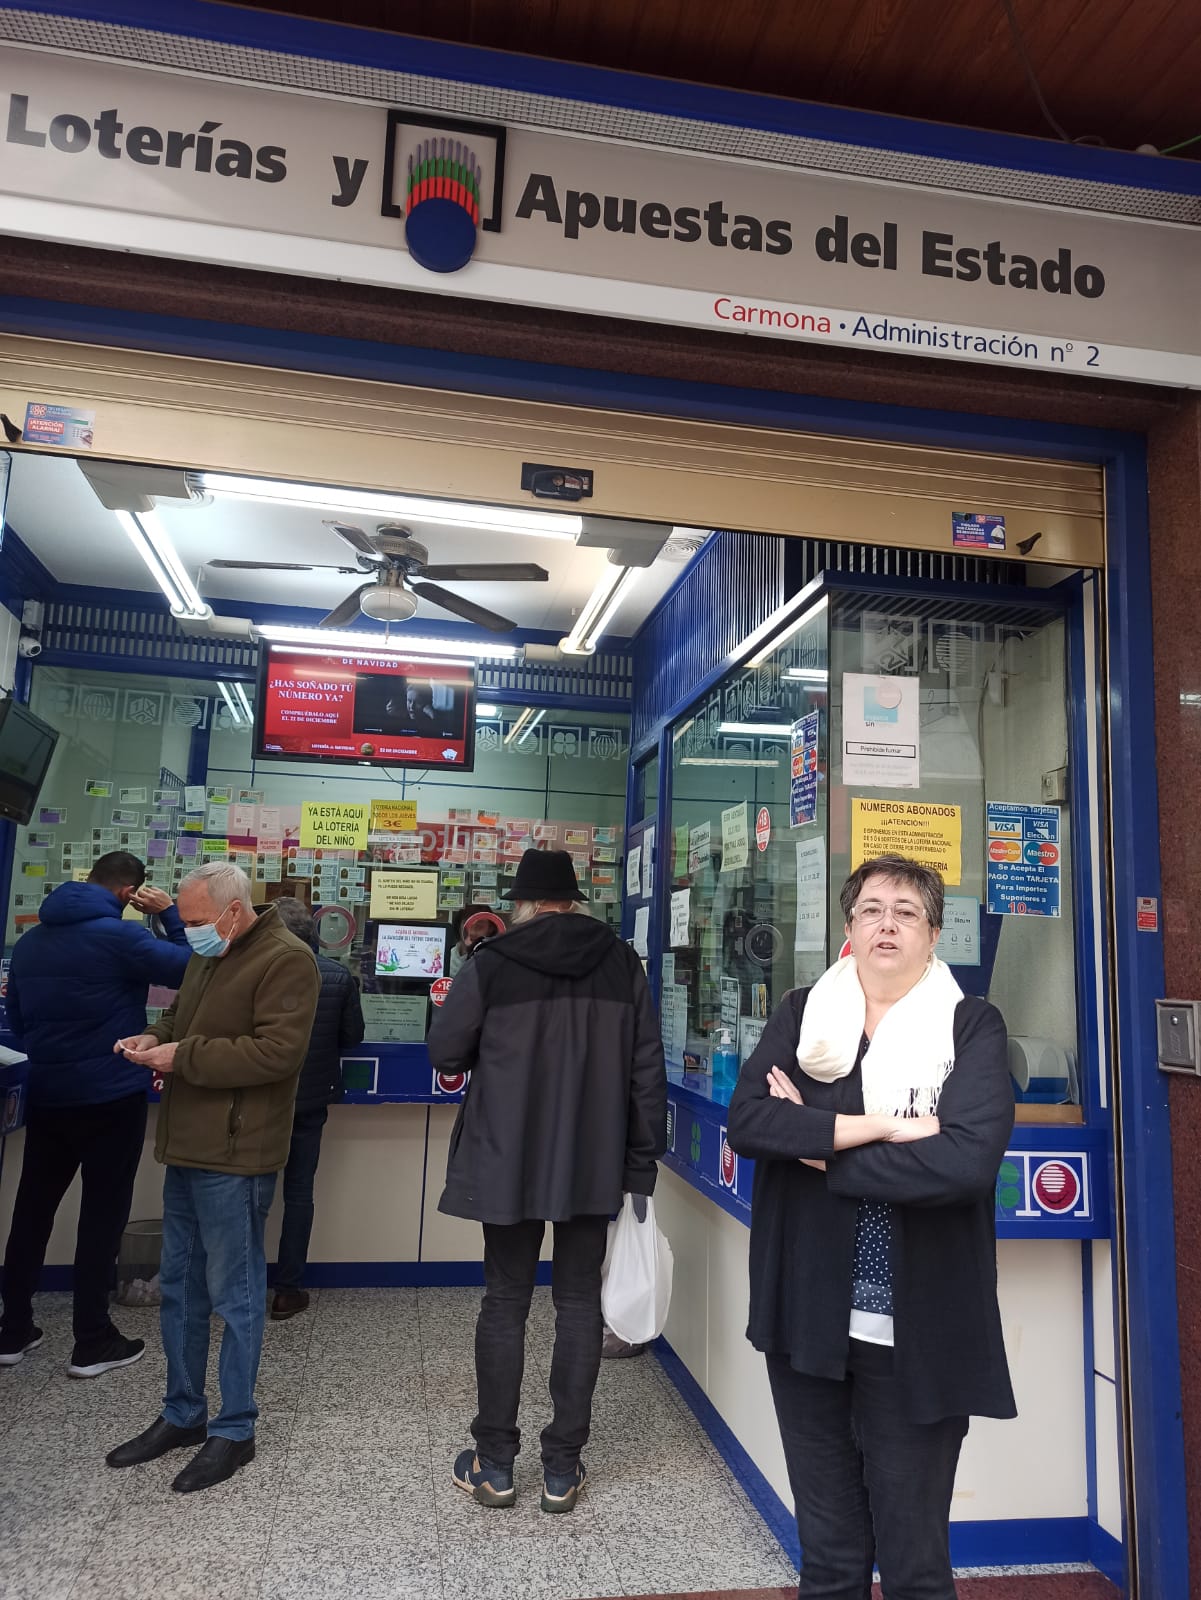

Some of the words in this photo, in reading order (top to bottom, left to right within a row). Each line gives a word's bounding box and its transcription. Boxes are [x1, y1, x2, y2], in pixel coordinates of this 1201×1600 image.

[6, 93, 287, 184] Loterías
[331, 155, 368, 206] y
[515, 172, 792, 256] Apuestas
[815, 214, 897, 270] del
[921, 229, 1106, 299] Estado
[713, 298, 831, 334] Carmona
[851, 315, 1039, 360] Administración
[1086, 345, 1101, 368] 2
[342, 658, 354, 666] DE
[356, 658, 398, 669] NAVIDAD
[270, 679, 295, 689] ¿HAS
[296, 680, 338, 692] SOÑADO
[340, 682, 353, 692] TÚ
[278, 688, 323, 701] NÚMERO
[324, 693, 344, 702] YA?
[886, 746, 902, 754] fumar
[308, 807, 319, 817] YA
[320, 806, 341, 817] ESTÁ
[343, 808, 364, 819] AQUÍ
[860, 801, 905, 814] NÚMEROS
[907, 805, 956, 817] ABONADOS
[989, 803, 1028, 812] Aceptamos
[1030, 806, 1058, 815] Tarjetas
[313, 821, 323, 831] LA
[383, 820, 402, 828] 3€
[994, 823, 1016, 832] VISA
[316, 834, 332, 845] DEL
[334, 834, 355, 846] NIÑO
[1027, 850, 1056, 858] Maestro
[1010, 865, 1037, 873] Acepta
[1026, 876, 1059, 884] TARJETA
[1016, 884, 1048, 893] Importes
[1000, 894, 1040, 902] Superiores
[1008, 902, 1027, 915] 10
